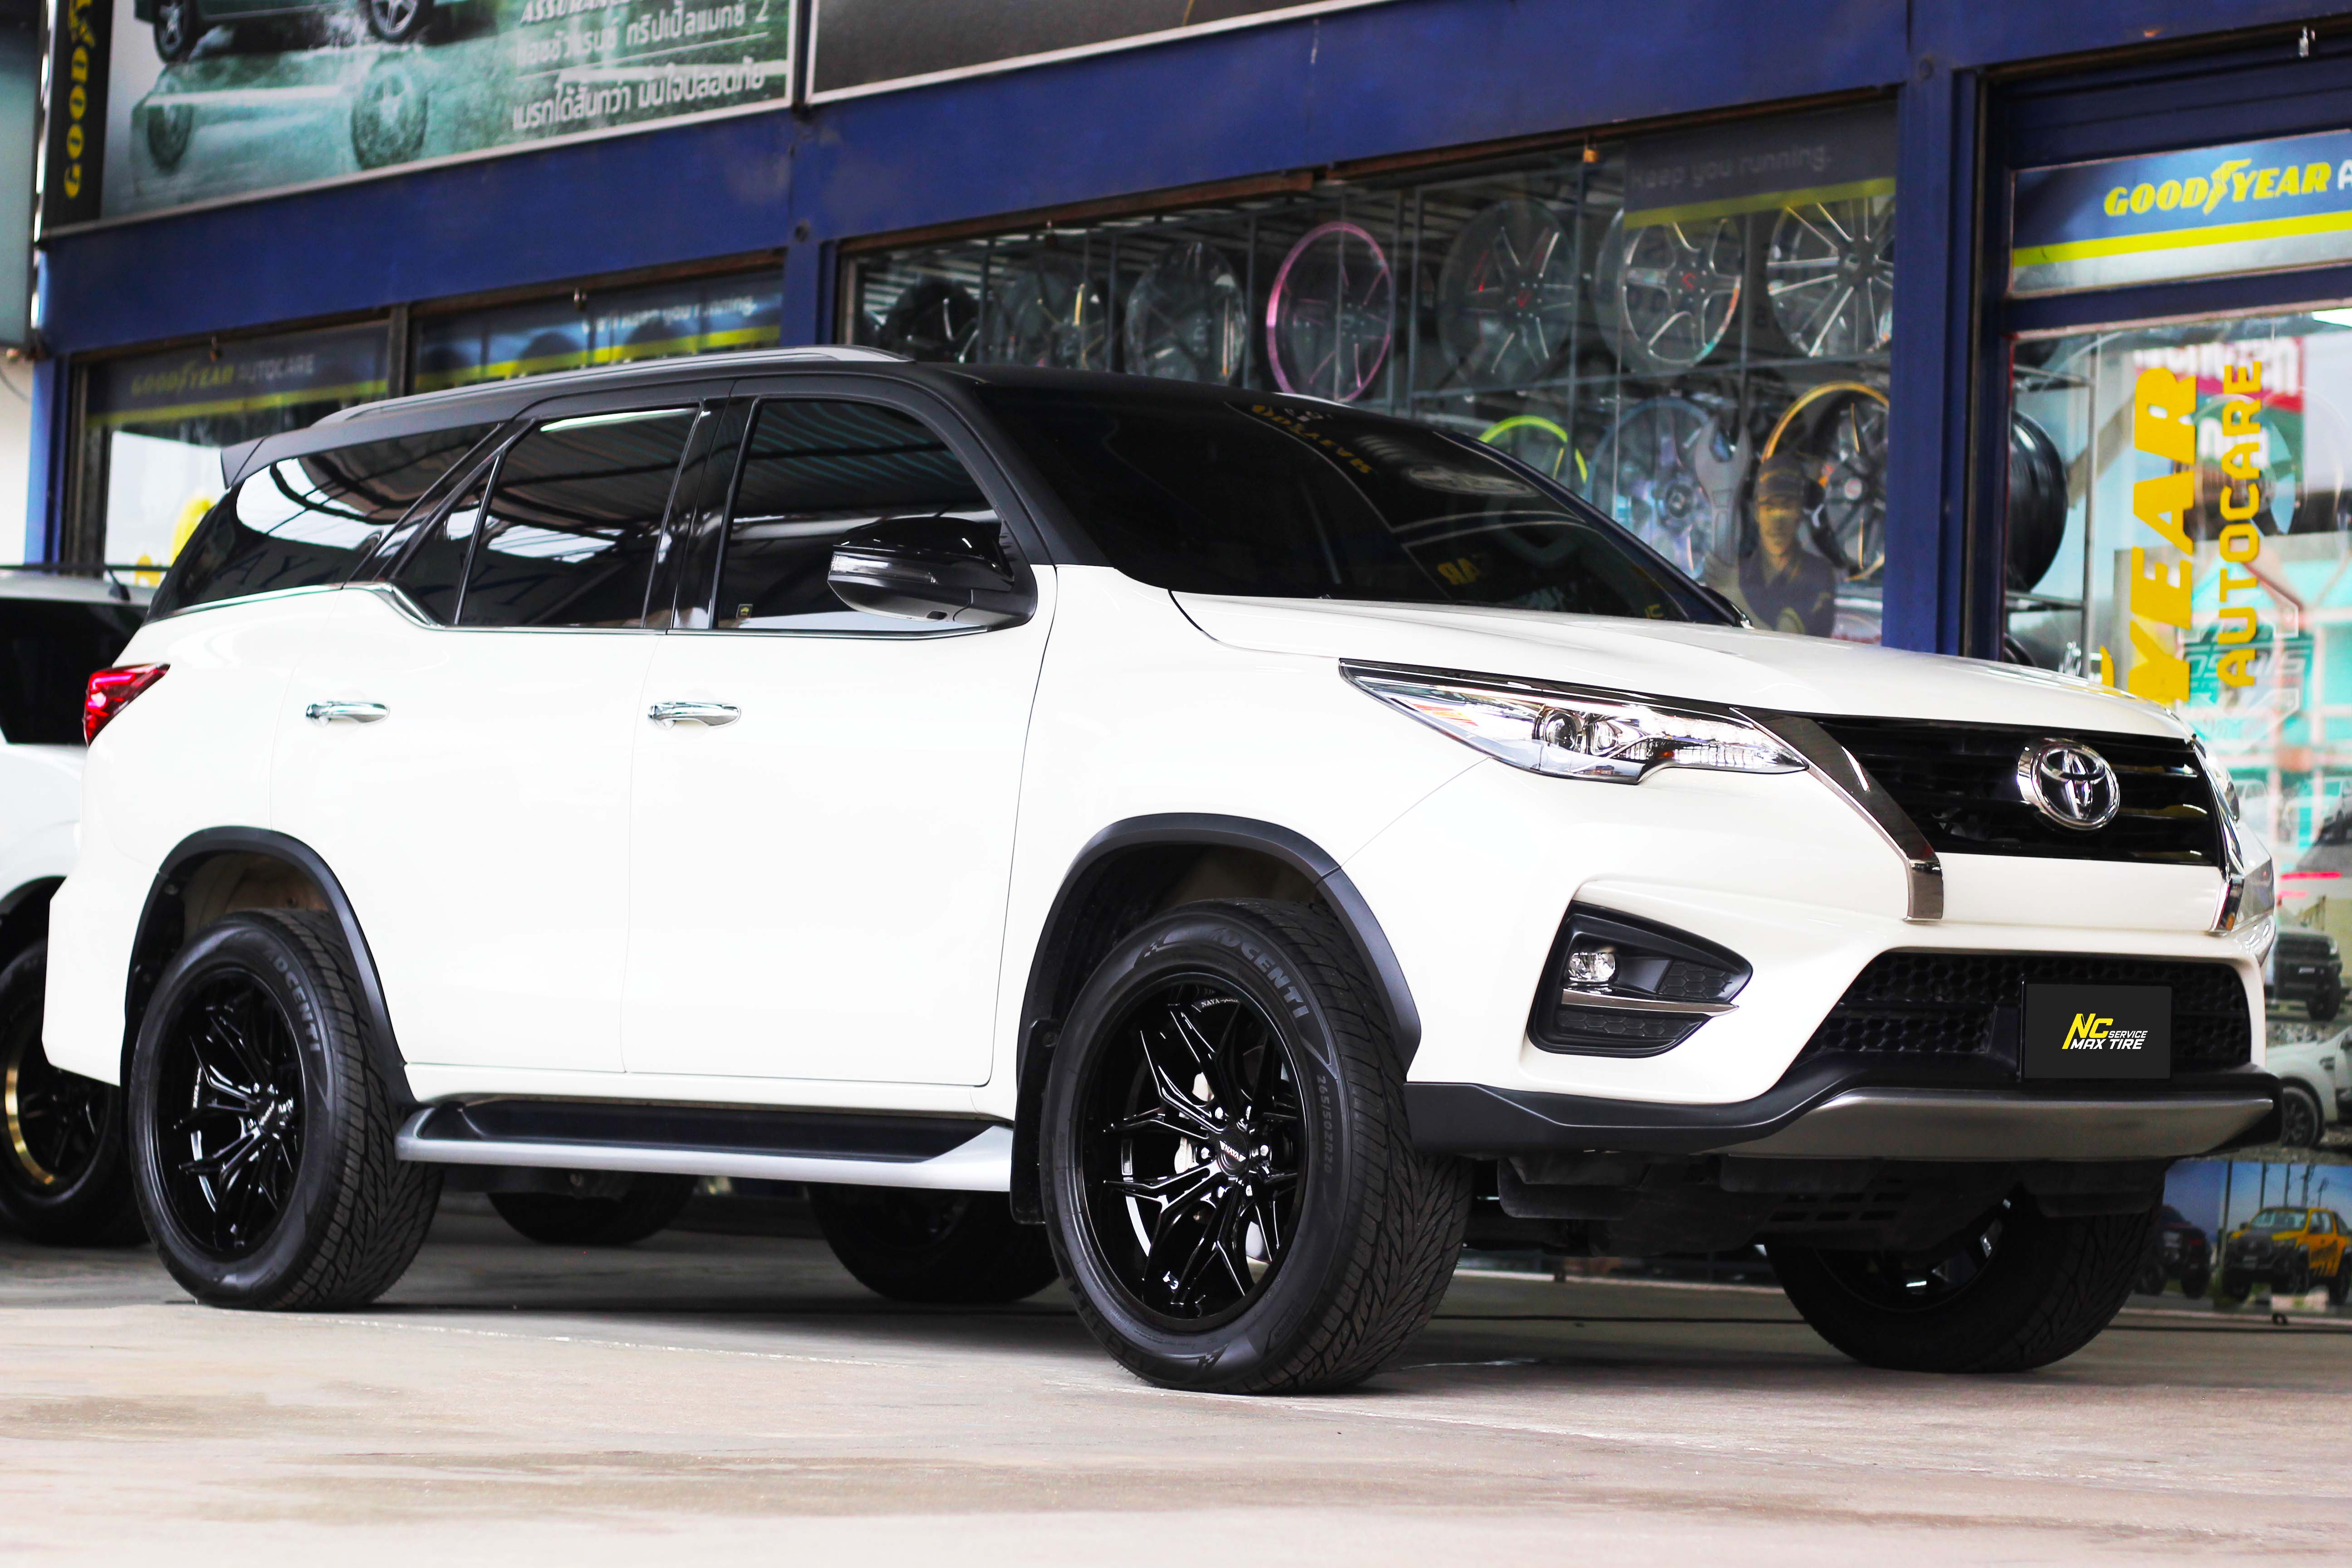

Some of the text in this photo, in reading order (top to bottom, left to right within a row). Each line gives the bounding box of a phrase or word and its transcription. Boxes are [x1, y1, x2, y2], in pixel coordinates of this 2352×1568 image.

[2104, 158, 2331, 216] GOODYEAR
[2217, 361, 2262, 688] AUTOCARE
[1201, 999, 1220, 1008] NAYA
